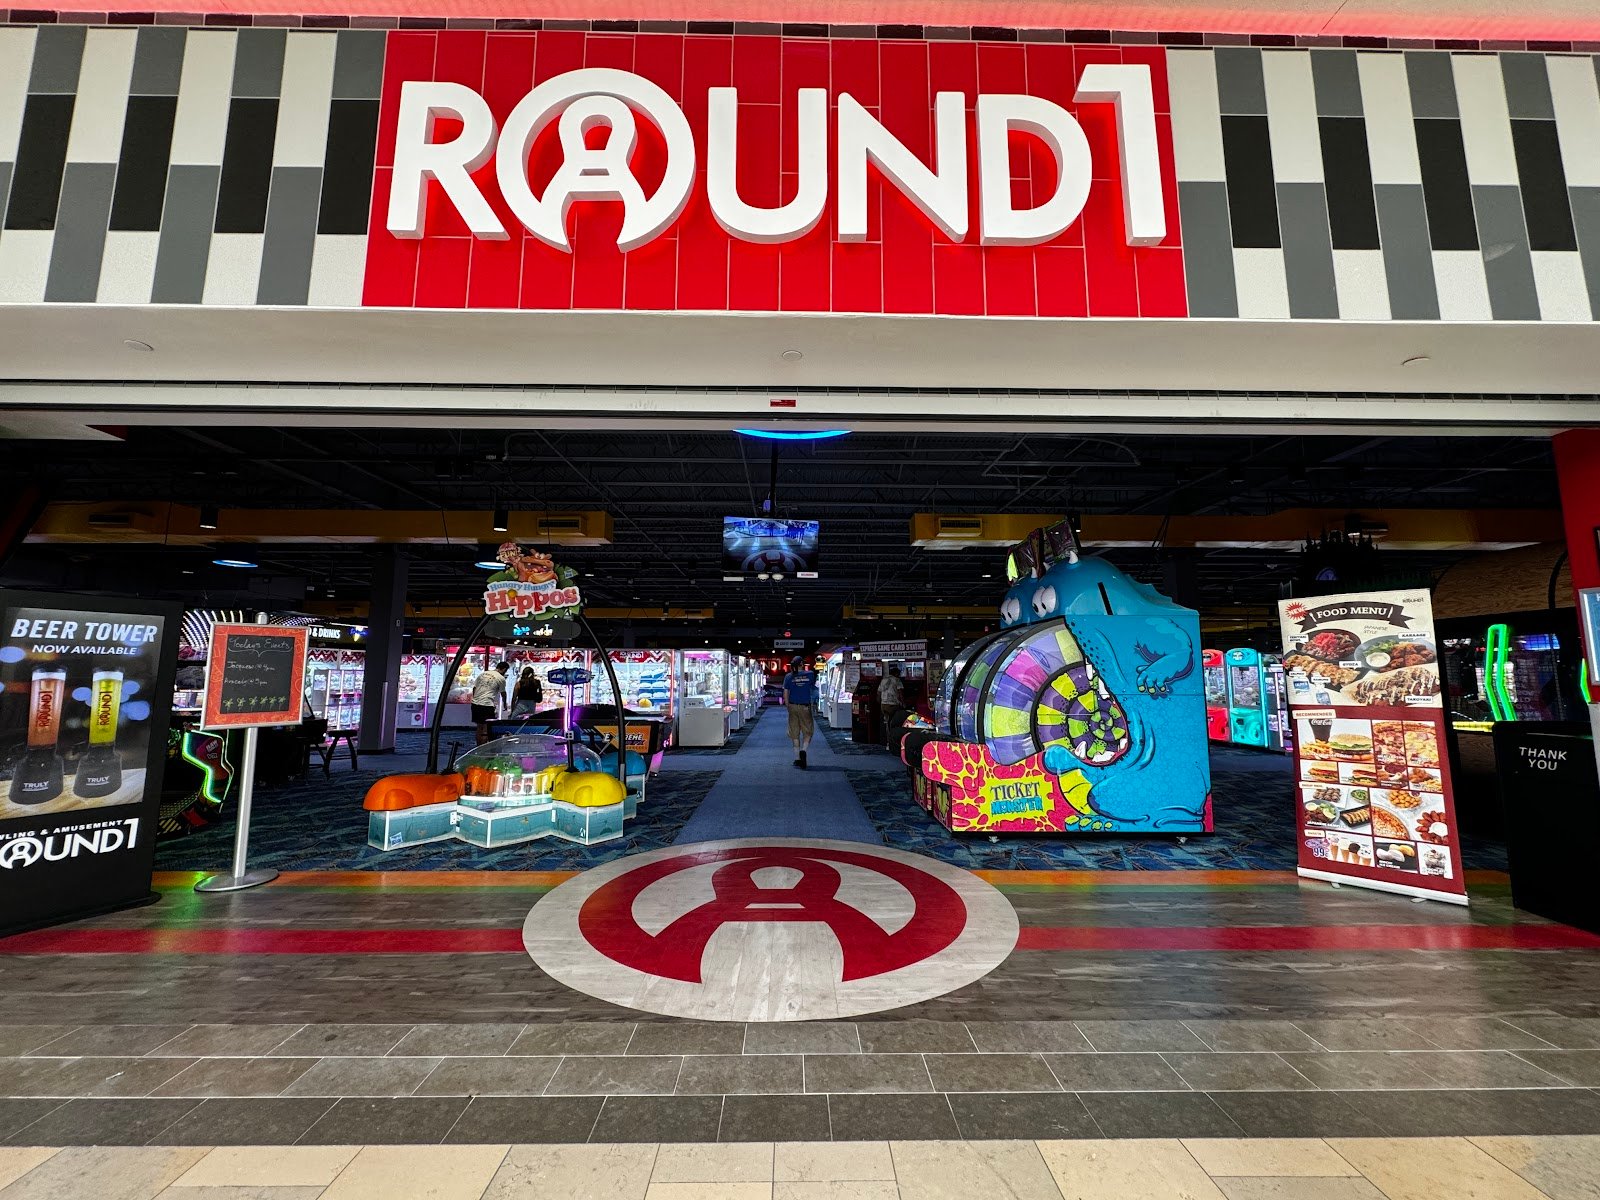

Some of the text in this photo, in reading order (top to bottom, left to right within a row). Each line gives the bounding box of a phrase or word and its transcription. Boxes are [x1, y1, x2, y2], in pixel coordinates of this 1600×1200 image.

[386, 63, 1167, 253] ROUND1
[489, 580, 556, 591] Hungry Hungry
[486, 588, 578, 616] Hippos
[1315, 606, 1388, 619] FOOD MENU
[11, 618, 158, 643] BEER TOWER
[32, 644, 138, 656] NOW AVAILABLE
[1518, 746, 1568, 761] THANK
[1528, 758, 1558, 771] YOU
[87, 775, 110, 783] TRULY
[990, 781, 1040, 801] TICKET
[40, 828, 49, 836] &
[53, 819, 122, 834] AMUSEMENT
